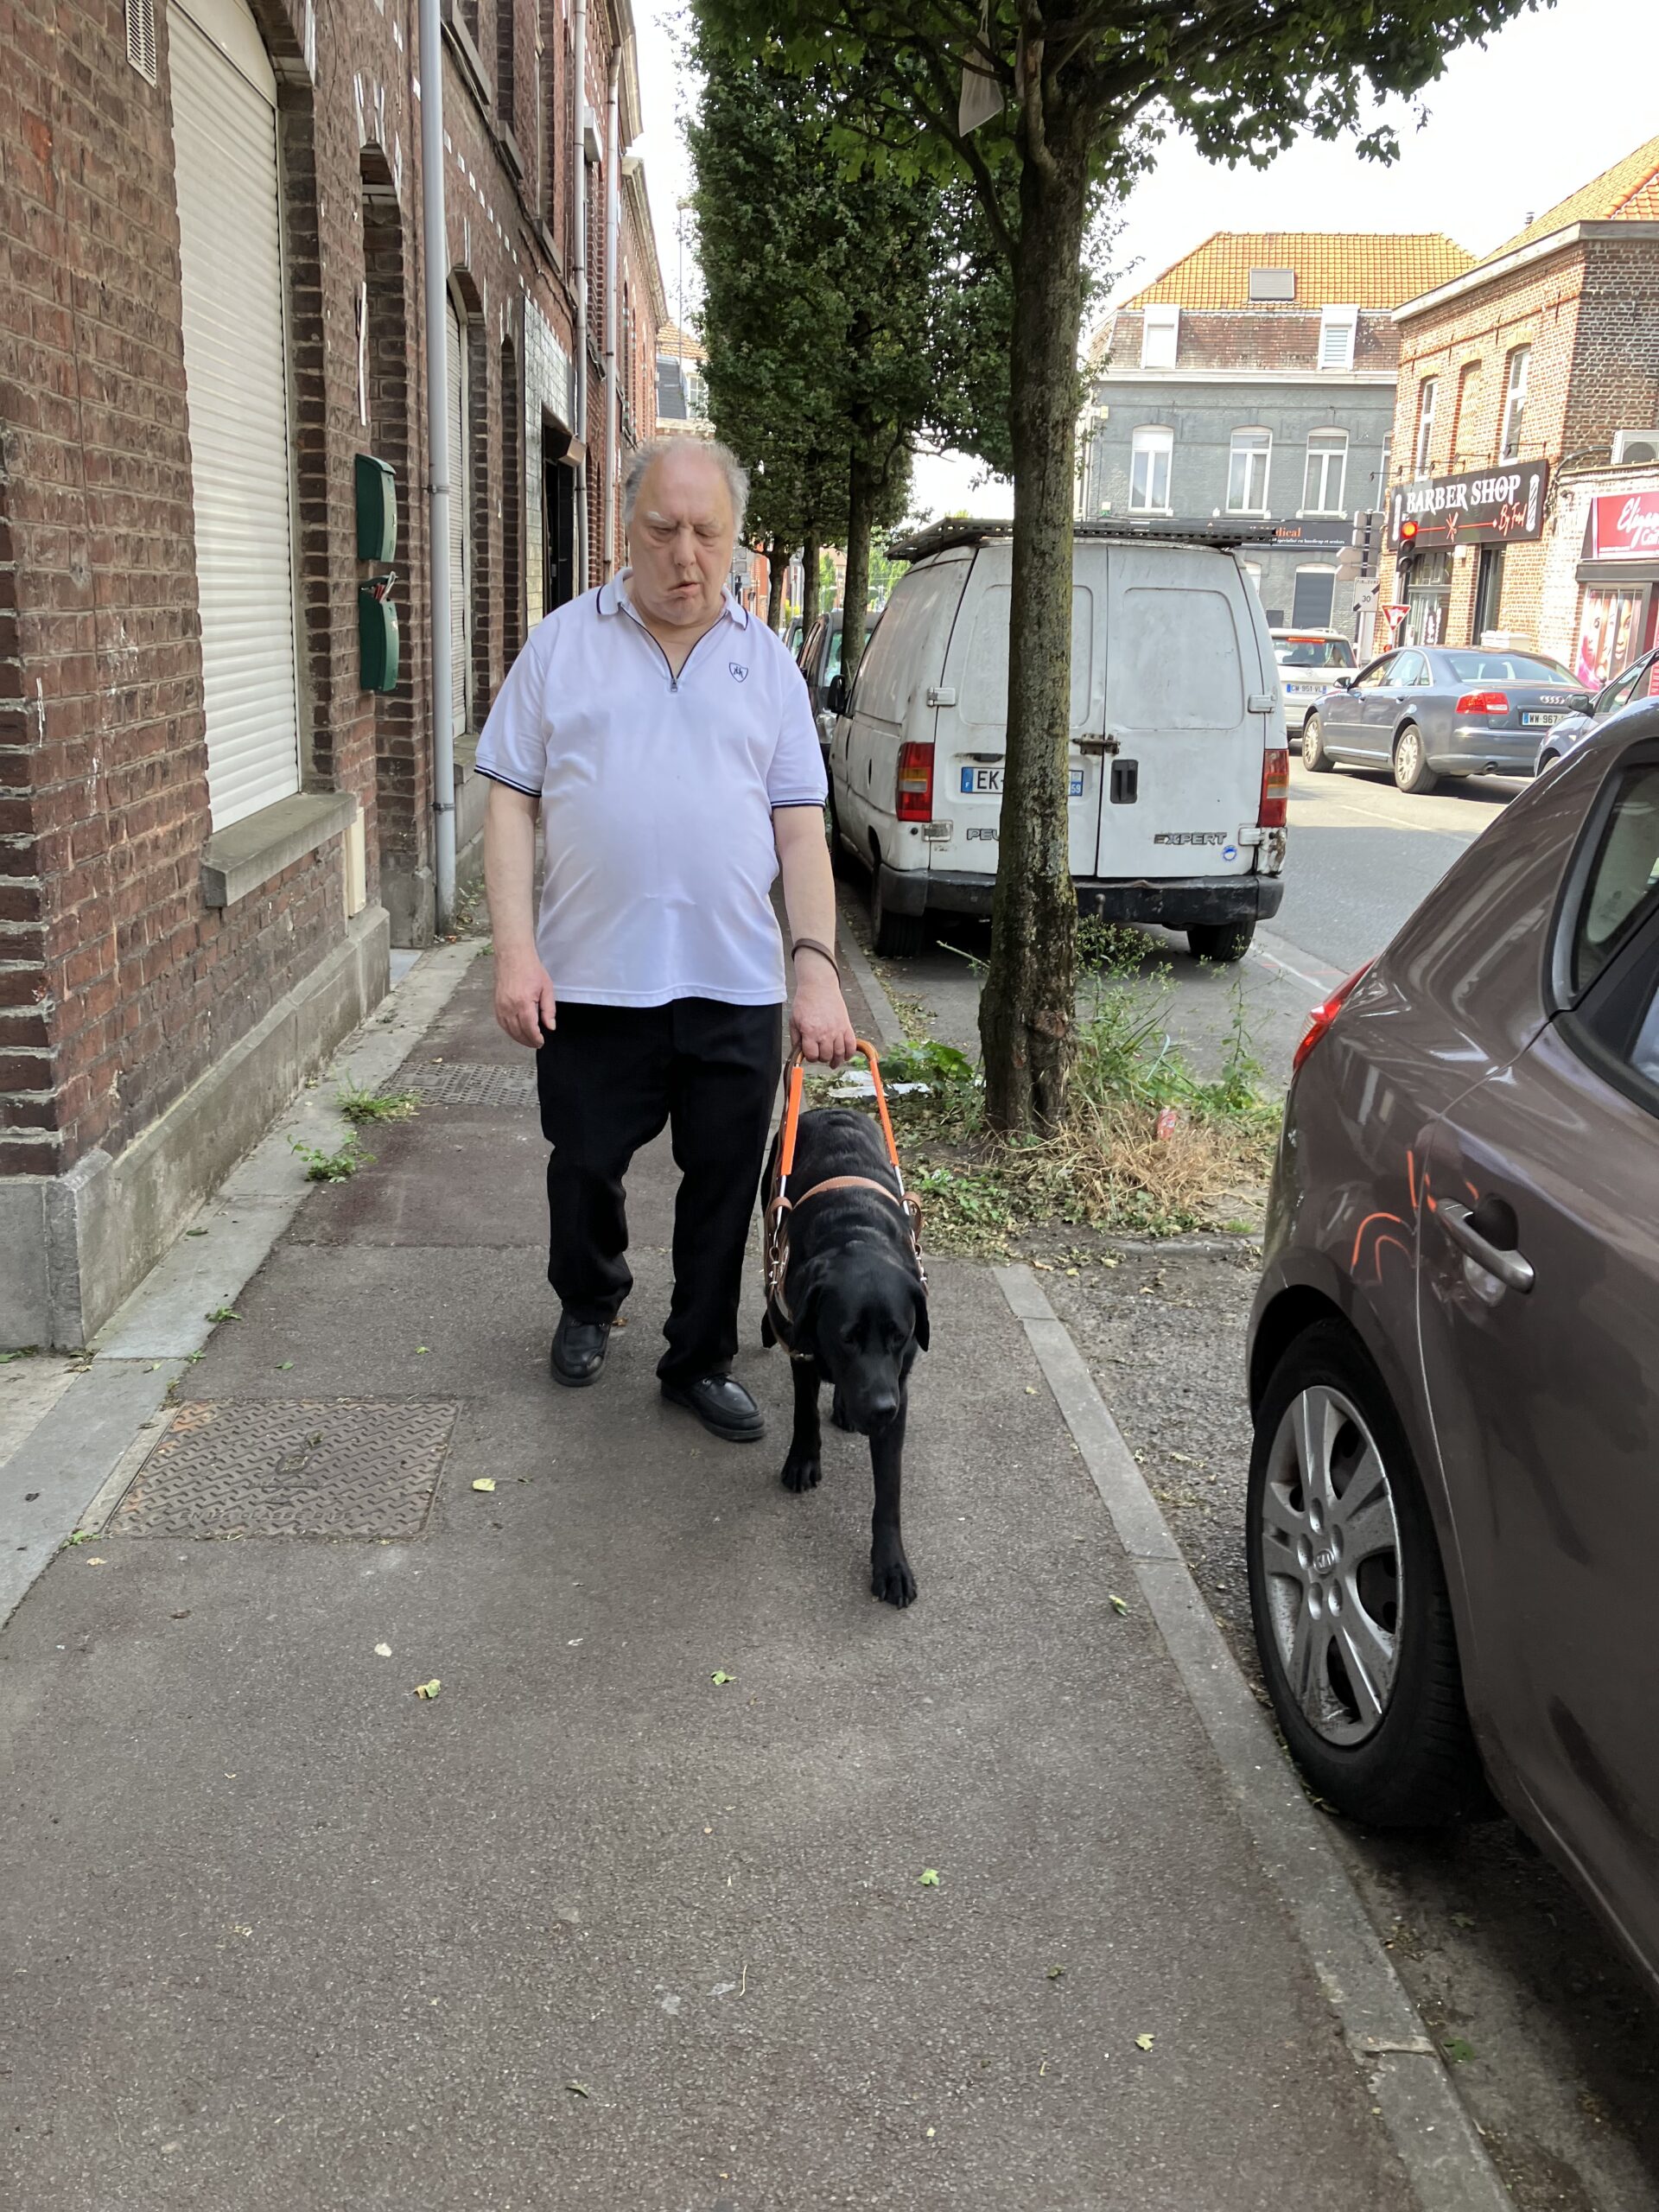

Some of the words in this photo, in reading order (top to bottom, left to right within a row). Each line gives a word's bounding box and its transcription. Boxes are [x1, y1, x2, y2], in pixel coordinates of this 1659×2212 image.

[1406, 483, 1469, 516] BARBER
[1471, 474, 1521, 505] SHOP
[1274, 526, 1302, 537] dical
[1071, 784, 1081, 794] 59
[1154, 832, 1227, 845] EXPERT
